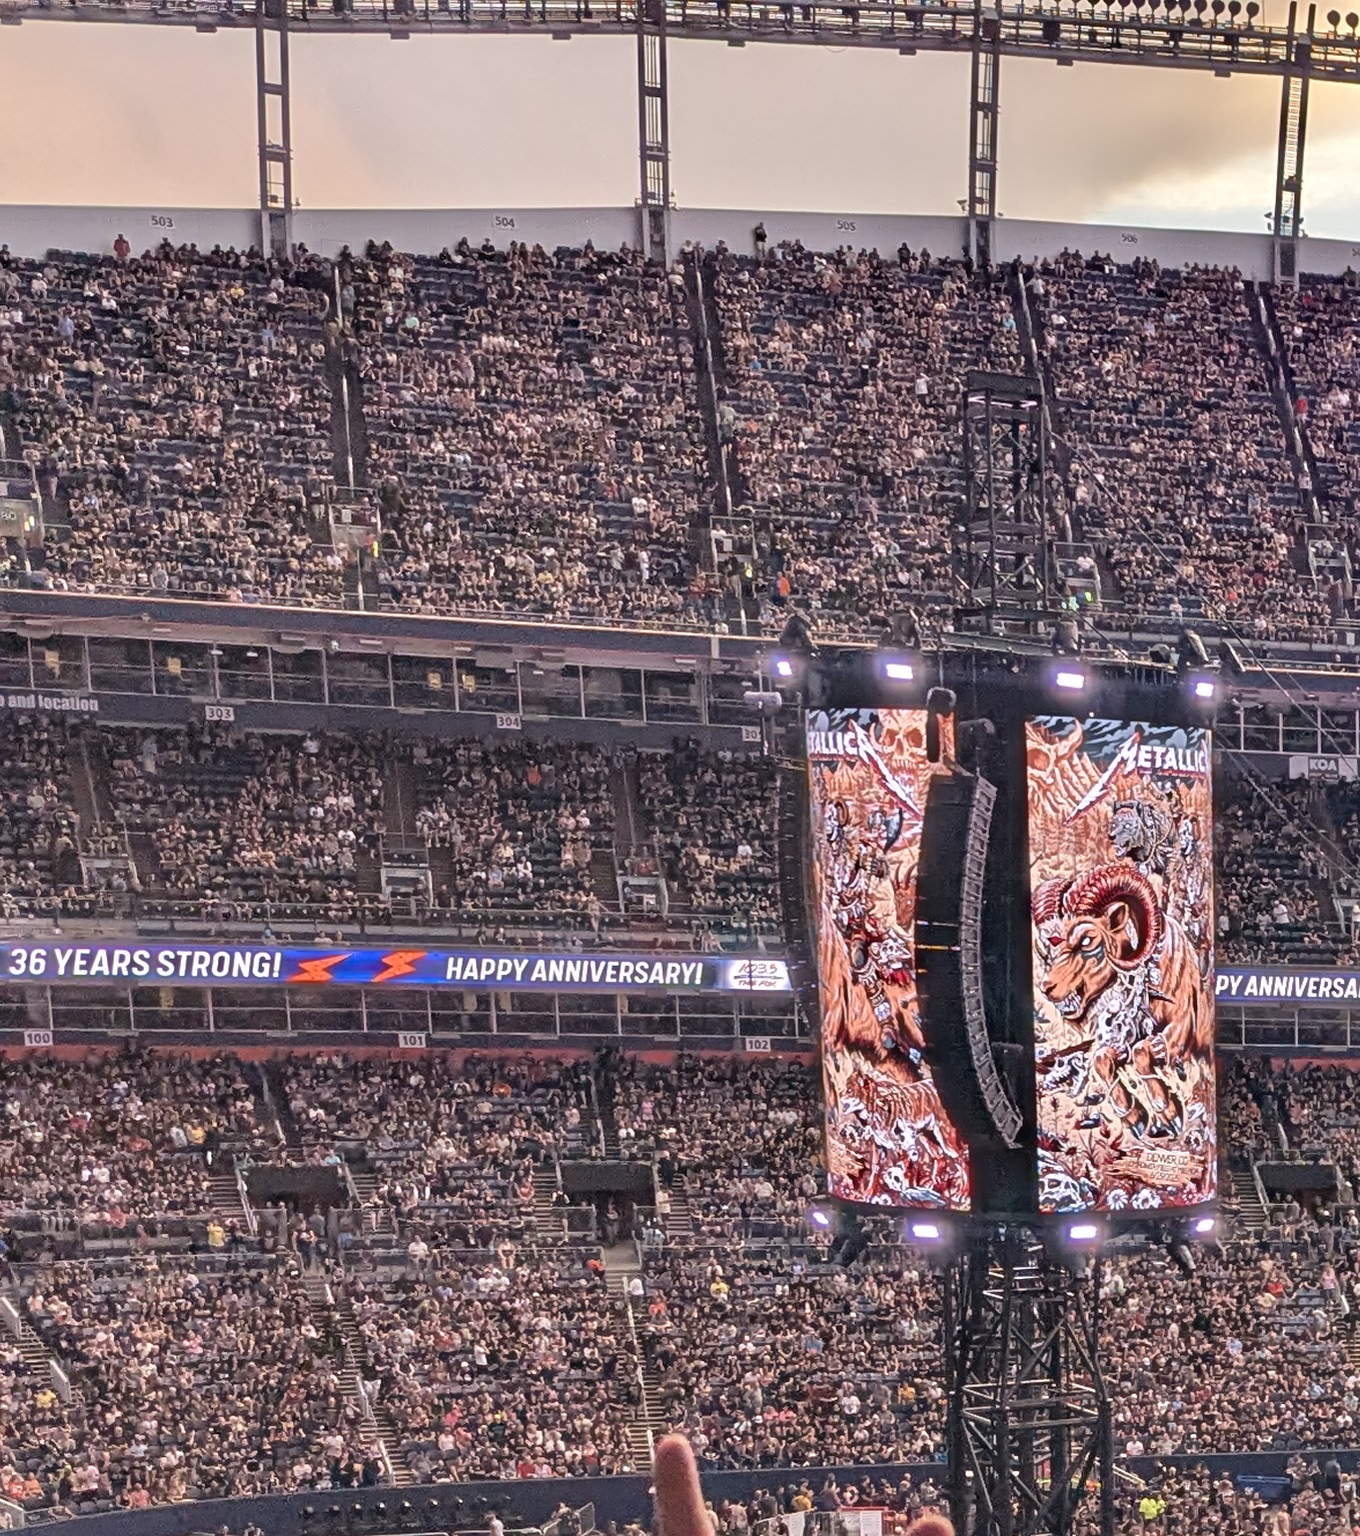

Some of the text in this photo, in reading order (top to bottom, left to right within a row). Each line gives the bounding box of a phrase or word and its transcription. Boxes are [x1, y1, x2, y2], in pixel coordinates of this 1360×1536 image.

[151, 214, 174, 228] 503
[494, 215, 515, 228] 504
[837, 220, 856, 231] 505
[38, 695, 99, 711] location
[208, 707, 231, 719] 303
[497, 715, 520, 728] 304
[744, 729, 761, 739] 30
[1310, 758, 1338, 771] KOA
[9, 948, 282, 978] 36 YEARS STRONG!
[446, 957, 704, 985] HAPPY ANNIVERSARY!
[27, 1032, 51, 1045] 100
[402, 1033, 425, 1046] 101
[747, 1039, 769, 1050] 102
